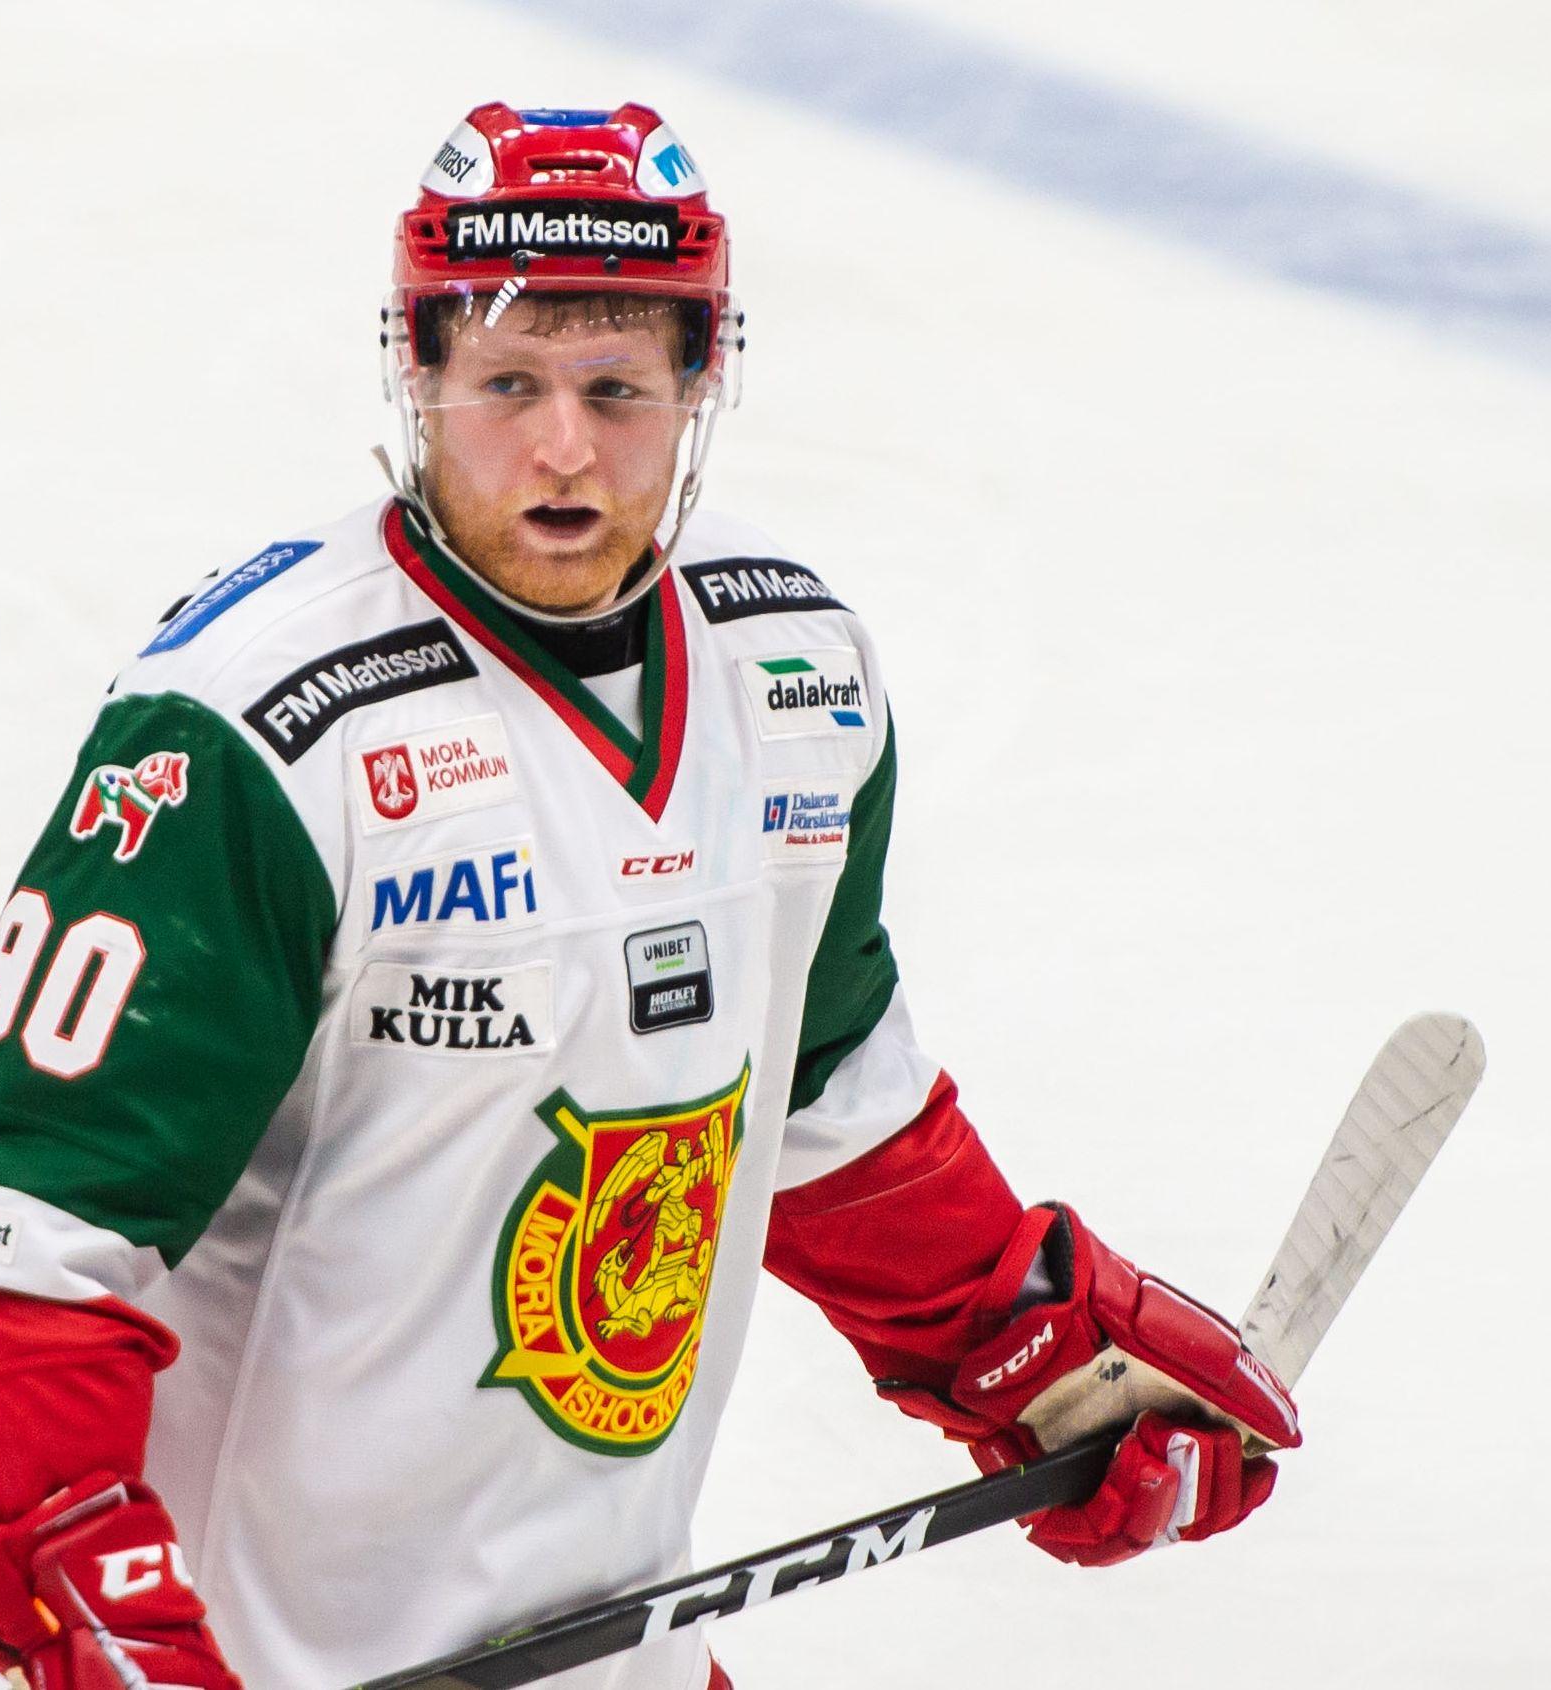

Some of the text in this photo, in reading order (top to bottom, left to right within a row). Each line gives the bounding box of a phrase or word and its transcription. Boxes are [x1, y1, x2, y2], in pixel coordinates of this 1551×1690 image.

[457, 211, 669, 249] FM Mattsson
[700, 570, 762, 608] FM
[263, 640, 460, 742] FM Mattsson
[767, 674, 862, 711] dalakraft
[419, 737, 481, 768] MORA
[426, 755, 510, 793] KOMMUN
[621, 850, 696, 877] CCM
[643, 936, 692, 962] UNIBET
[409, 974, 505, 1013] MIK
[651, 984, 698, 1009] HOCKEY
[369, 1005, 536, 1050] KULLA
[516, 1209, 567, 1347] MORA
[975, 1321, 1054, 1390] CCM
[640, 1505, 937, 1647] CCM
